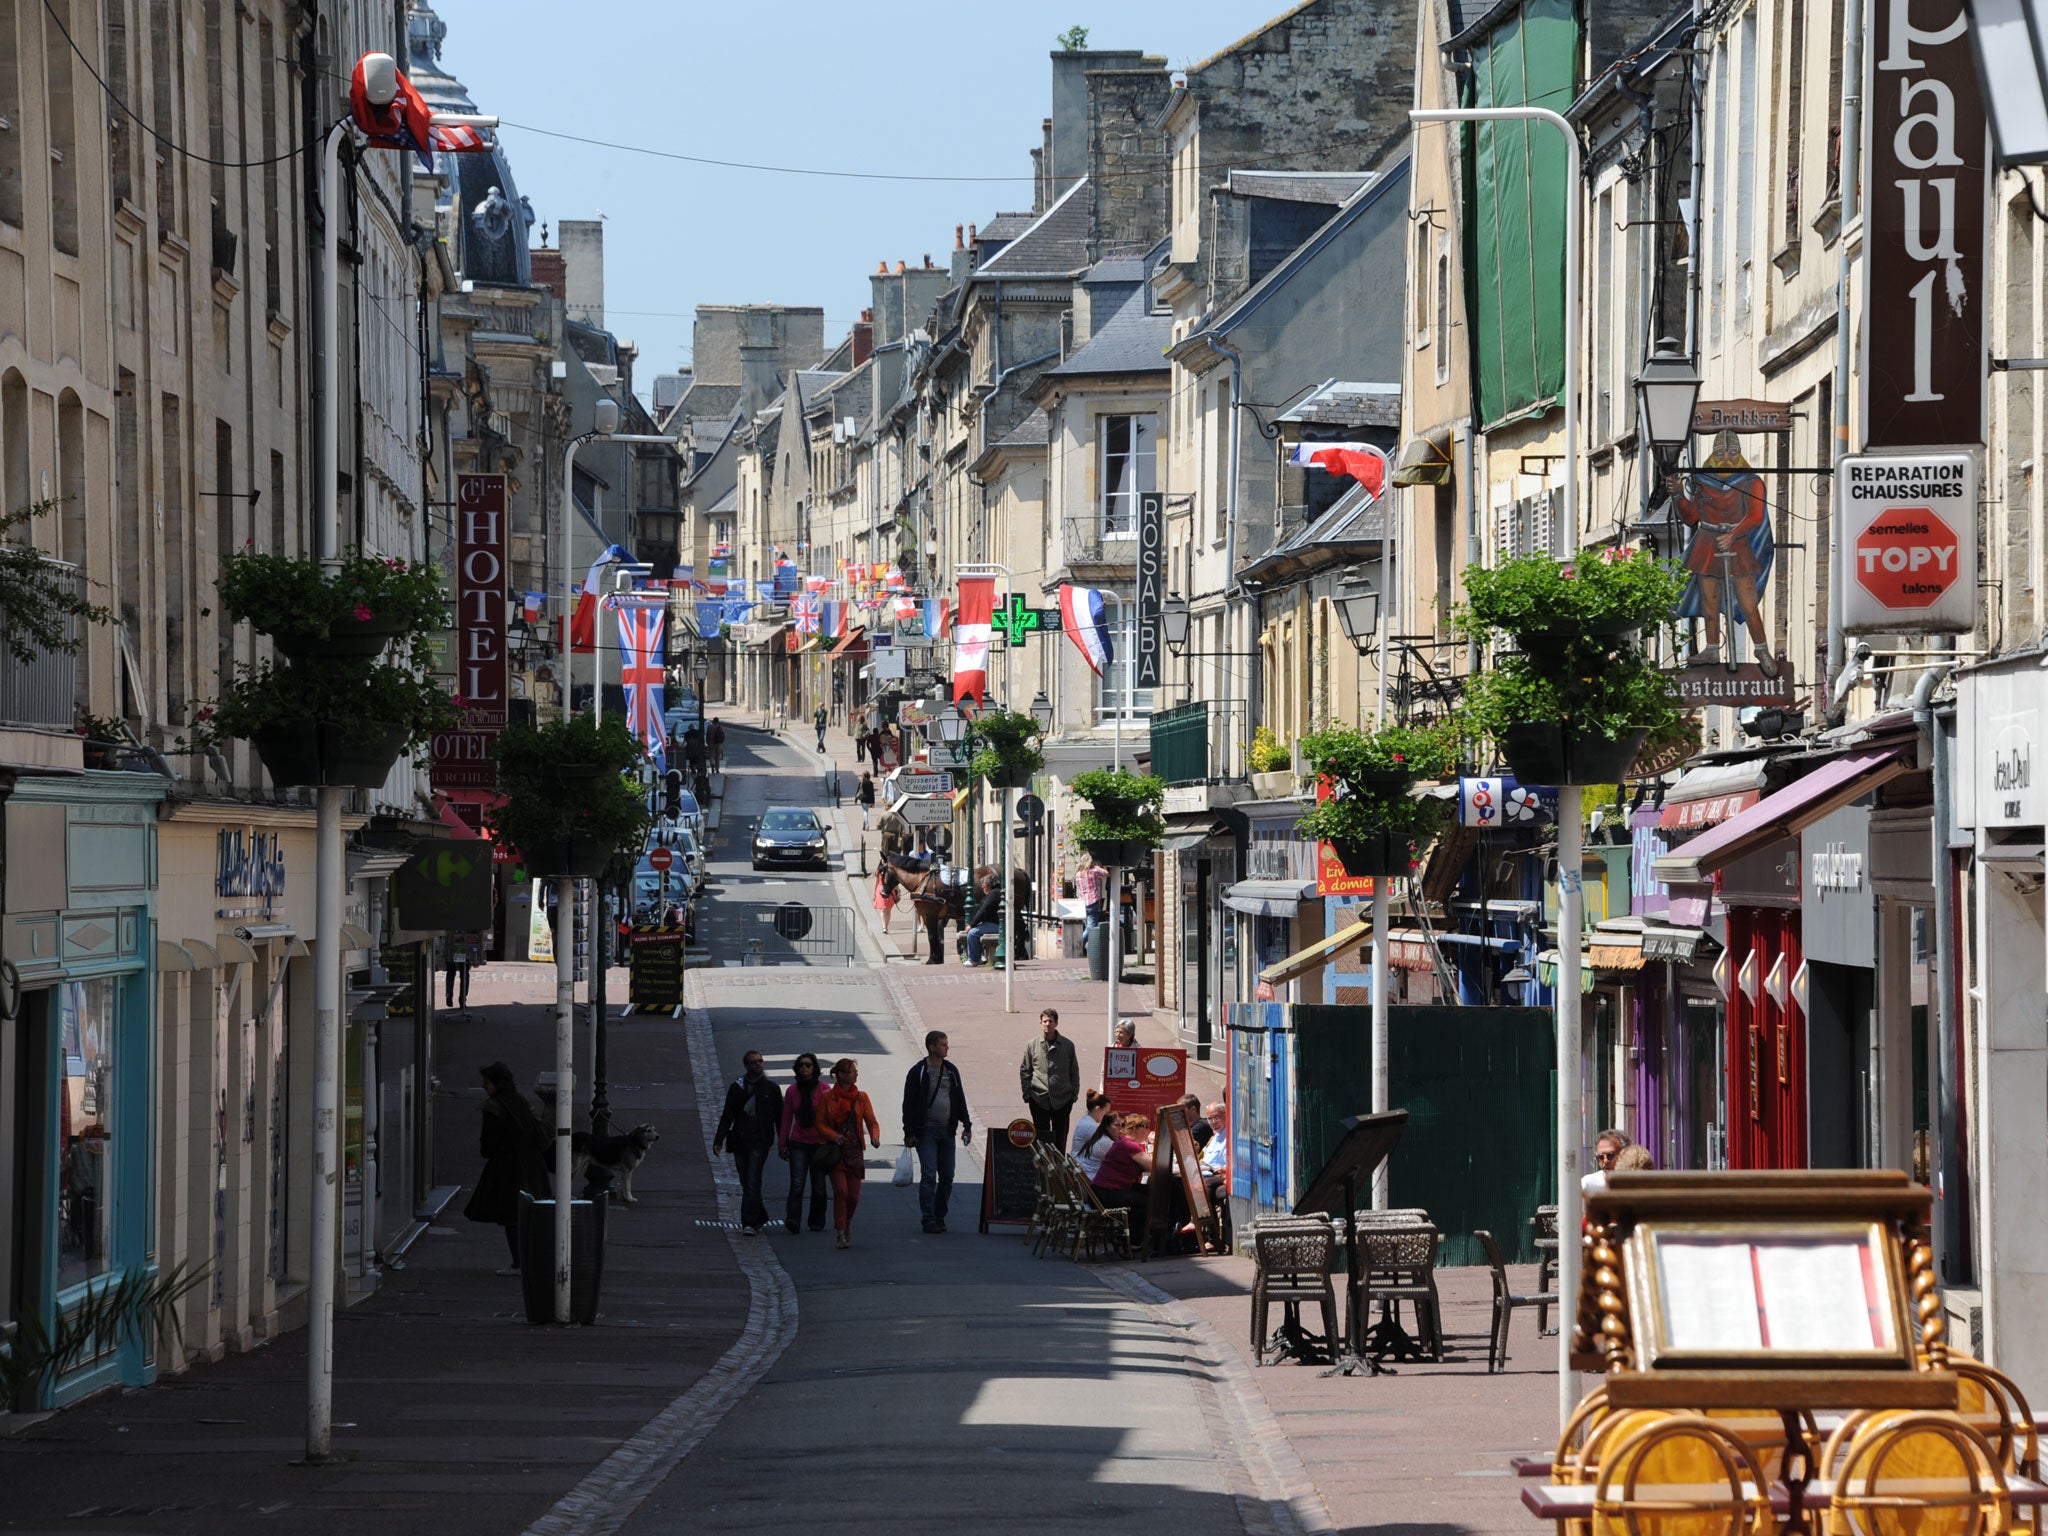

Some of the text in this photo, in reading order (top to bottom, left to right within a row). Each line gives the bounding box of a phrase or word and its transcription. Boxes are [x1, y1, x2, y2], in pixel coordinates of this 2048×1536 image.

[1711, 407, 1779, 427] Drakkar
[1851, 464, 1964, 481] RÉPARATION
[1851, 483, 1963, 499] CHAUSSURES
[1868, 523, 1929, 535] semelles
[1858, 545, 1956, 573] TOPY
[1140, 499, 1159, 682] ROSALBA
[1902, 583, 1943, 594] talons
[462, 511, 501, 700] HOTEL
[433, 734, 493, 760] OTEL
[904, 776, 939, 784] Tapisserie
[912, 784, 939, 792] Hôpital
[1010, 1130, 1034, 1138] PELFORTH
